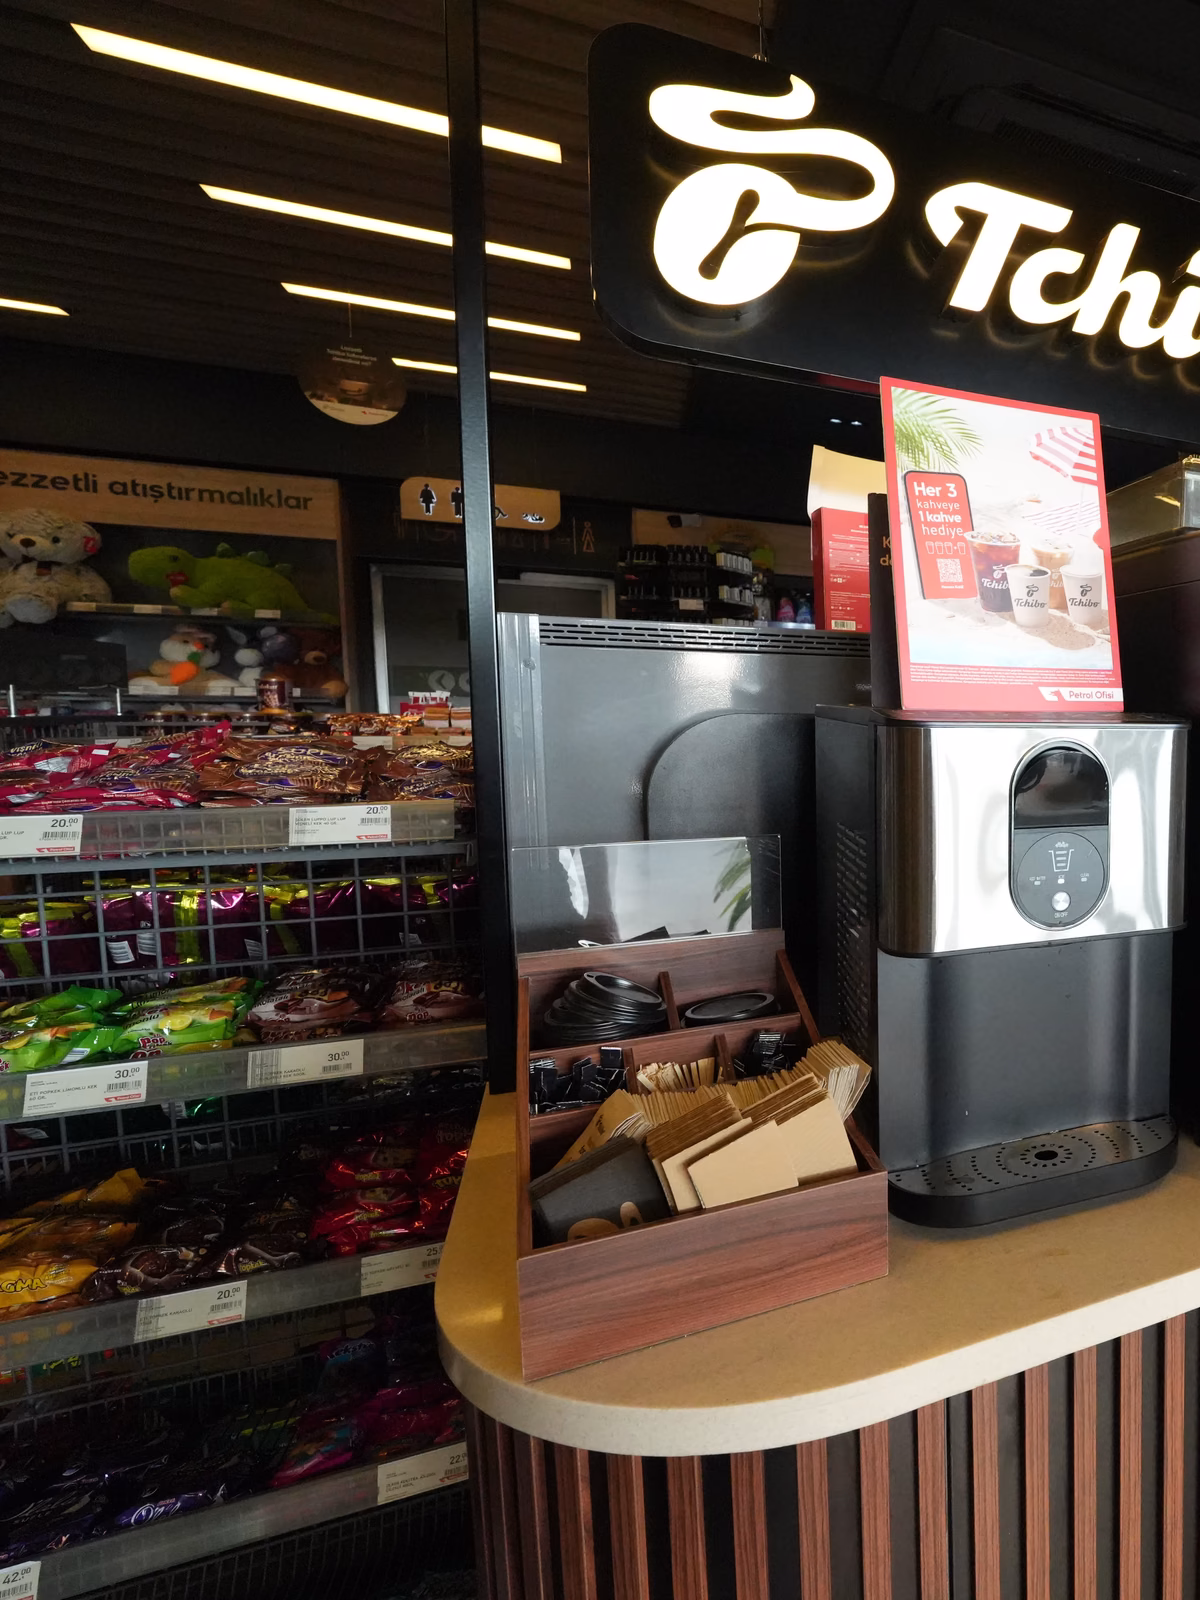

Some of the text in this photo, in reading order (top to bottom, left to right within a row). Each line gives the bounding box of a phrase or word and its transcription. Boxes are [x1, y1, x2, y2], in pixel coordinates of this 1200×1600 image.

[109, 479, 313, 511] atıştırmalıklar
[913, 481, 957, 498] Her 3
[916, 499, 960, 512] kahveye
[918, 510, 962, 523] 1 kahve
[921, 524, 964, 539] hediye
[981, 578, 1010, 590] Tchib
[1014, 598, 1047, 609] Tchibo
[1068, 598, 1100, 608] Tchibo
[1069, 690, 1114, 699] Petrol Ofisi
[366, 806, 388, 815] 20.00
[50, 818, 79, 828] 20.00
[327, 1051, 350, 1062] 30.00
[114, 1067, 140, 1079] 30.00
[0, 1278, 46, 1294] GMA
[217, 1287, 240, 1300] 20.00
[2, 1567, 31, 1584] 42.00
